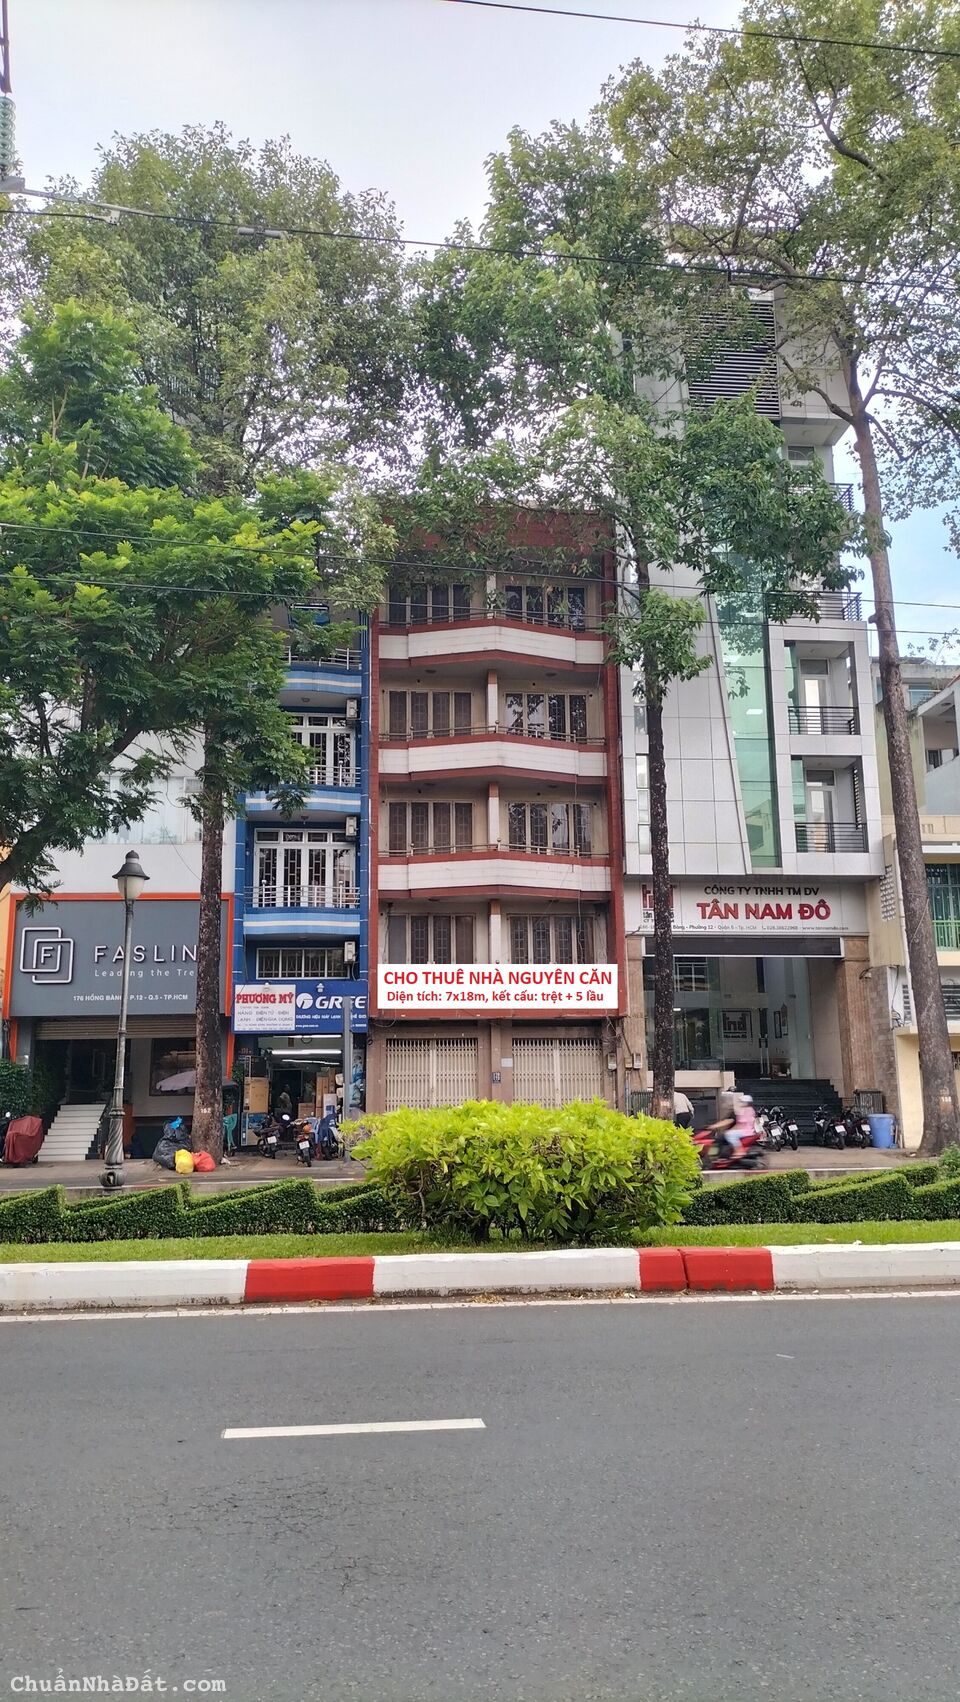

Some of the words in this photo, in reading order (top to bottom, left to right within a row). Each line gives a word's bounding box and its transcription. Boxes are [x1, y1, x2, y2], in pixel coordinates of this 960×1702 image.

[704, 884, 735, 895] CÔNG
[738, 887, 751, 895] TY
[754, 887, 784, 896] TNHH
[786, 887, 801, 896] TM
[697, 898, 738, 920] TÂN
[745, 904, 792, 920] NAM
[798, 898, 831, 920] ĐÔ
[94, 945, 197, 963] FASLIN
[94, 968, 144, 978] Leadng
[151, 968, 170, 976] the
[316, 996, 367, 1009] GRE
